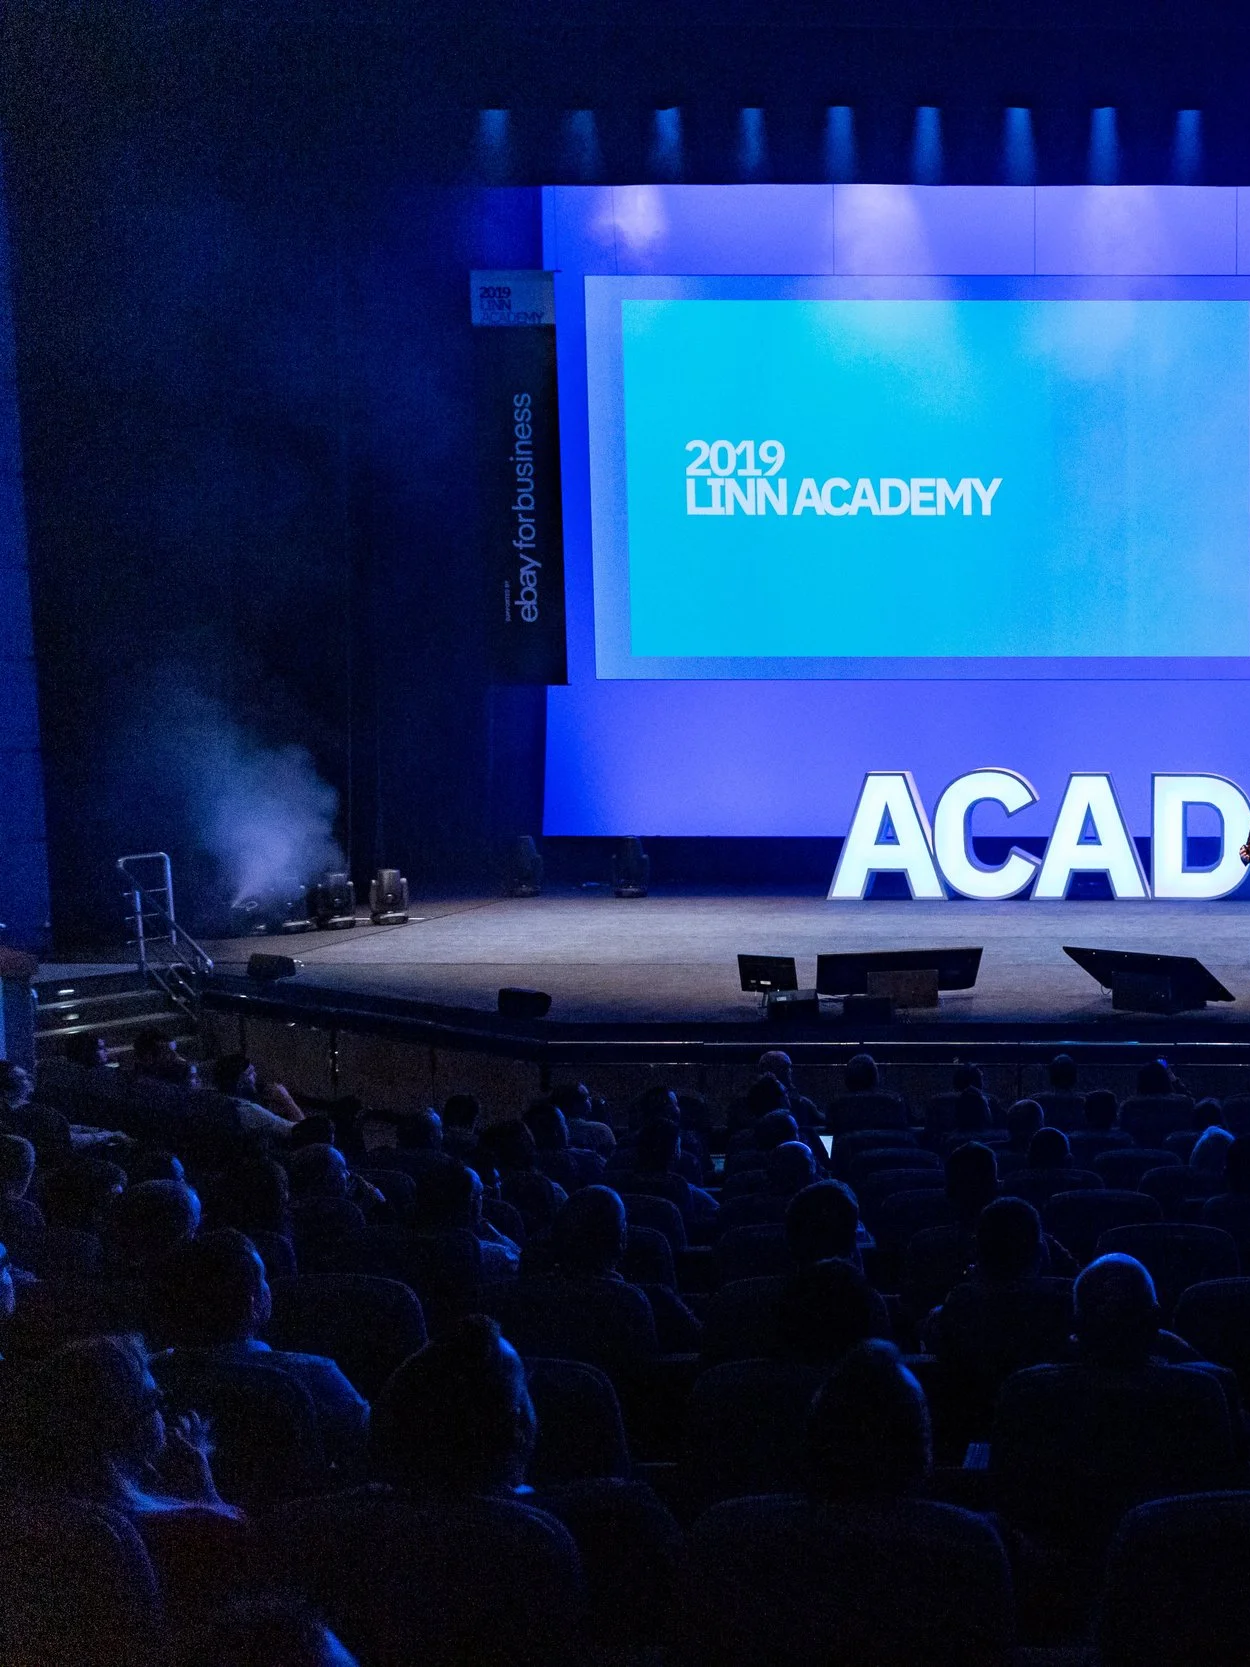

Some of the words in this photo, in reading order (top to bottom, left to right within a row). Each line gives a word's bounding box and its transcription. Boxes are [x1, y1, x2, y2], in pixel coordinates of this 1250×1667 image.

[479, 286, 512, 299] 2019
[510, 392, 535, 511] business
[685, 439, 786, 477] 2019
[685, 477, 788, 516] LINN
[792, 477, 1003, 517] ACADEMY
[512, 512, 536, 551] for
[513, 552, 542, 623] ebay
